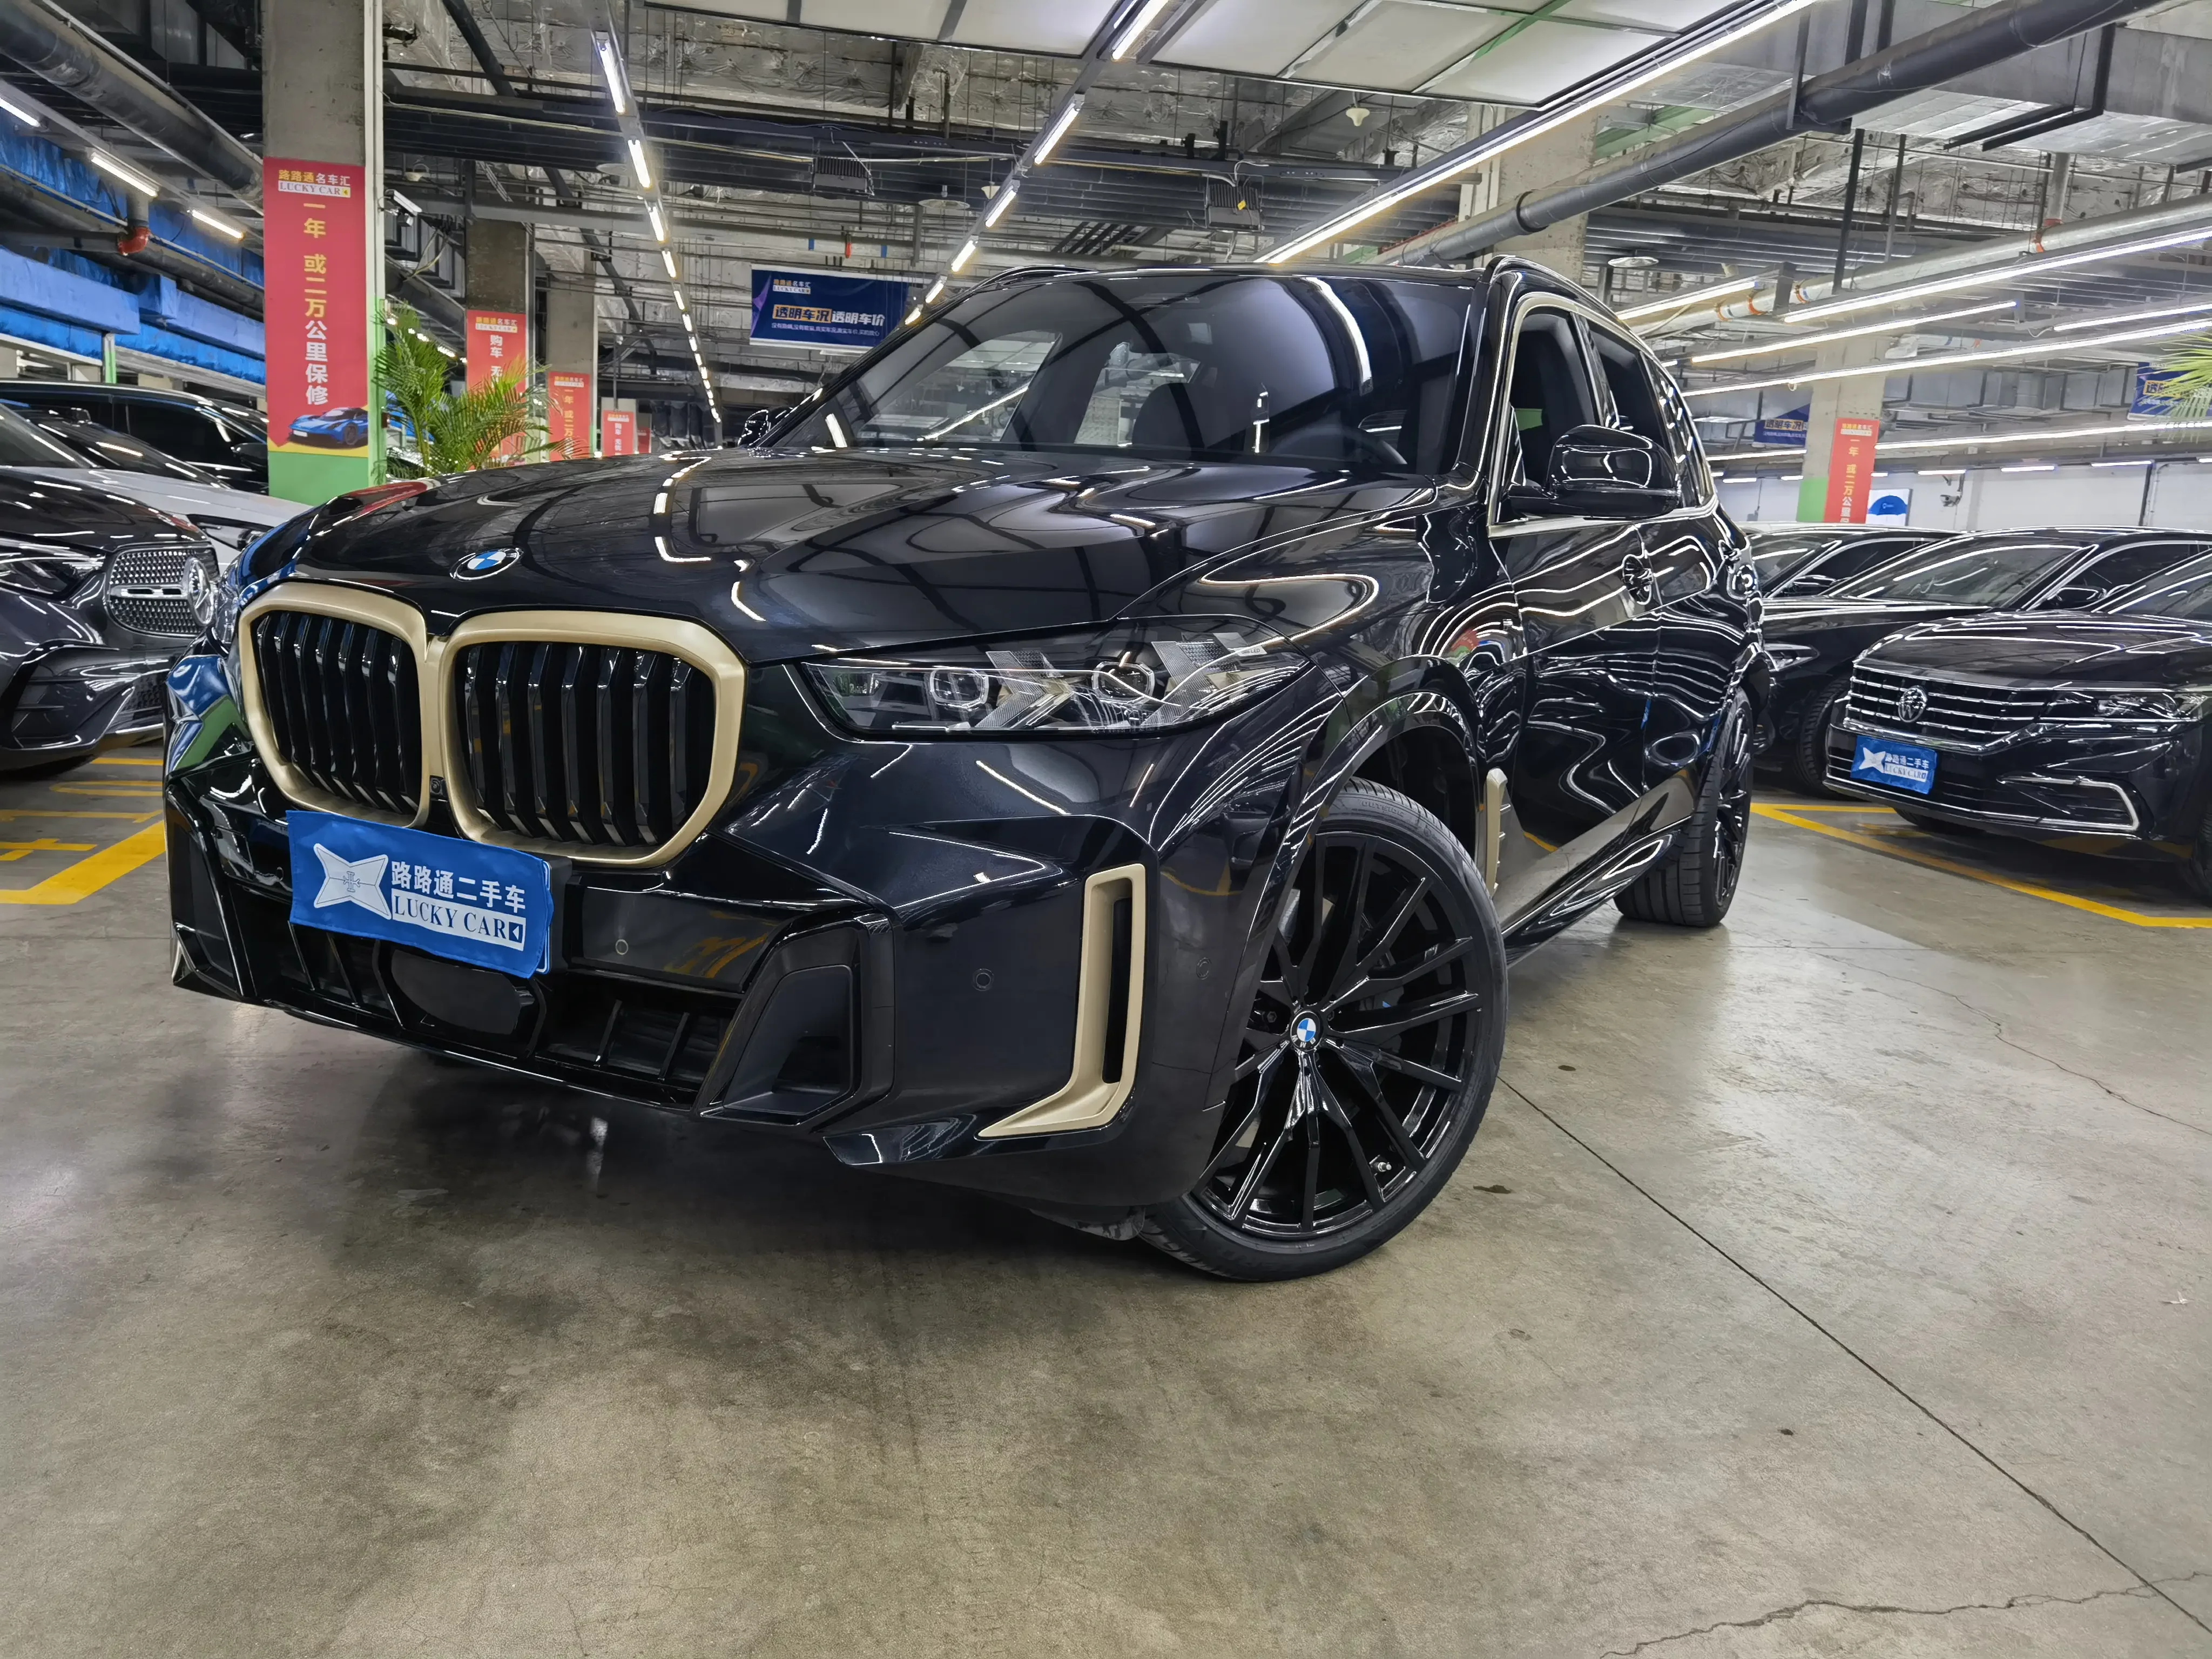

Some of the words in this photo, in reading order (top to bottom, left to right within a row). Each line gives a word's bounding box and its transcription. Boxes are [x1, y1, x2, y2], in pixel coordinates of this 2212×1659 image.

[278, 169, 350, 186] 路路通名车汇
[280, 182, 316, 193] LUCKY
[319, 185, 340, 195] CAR
[1885, 753, 1930, 770] 路路通二手车
[391, 861, 526, 914] 路路通二手车
[394, 895, 459, 929] LUCKY
[463, 913, 507, 939] CAR
